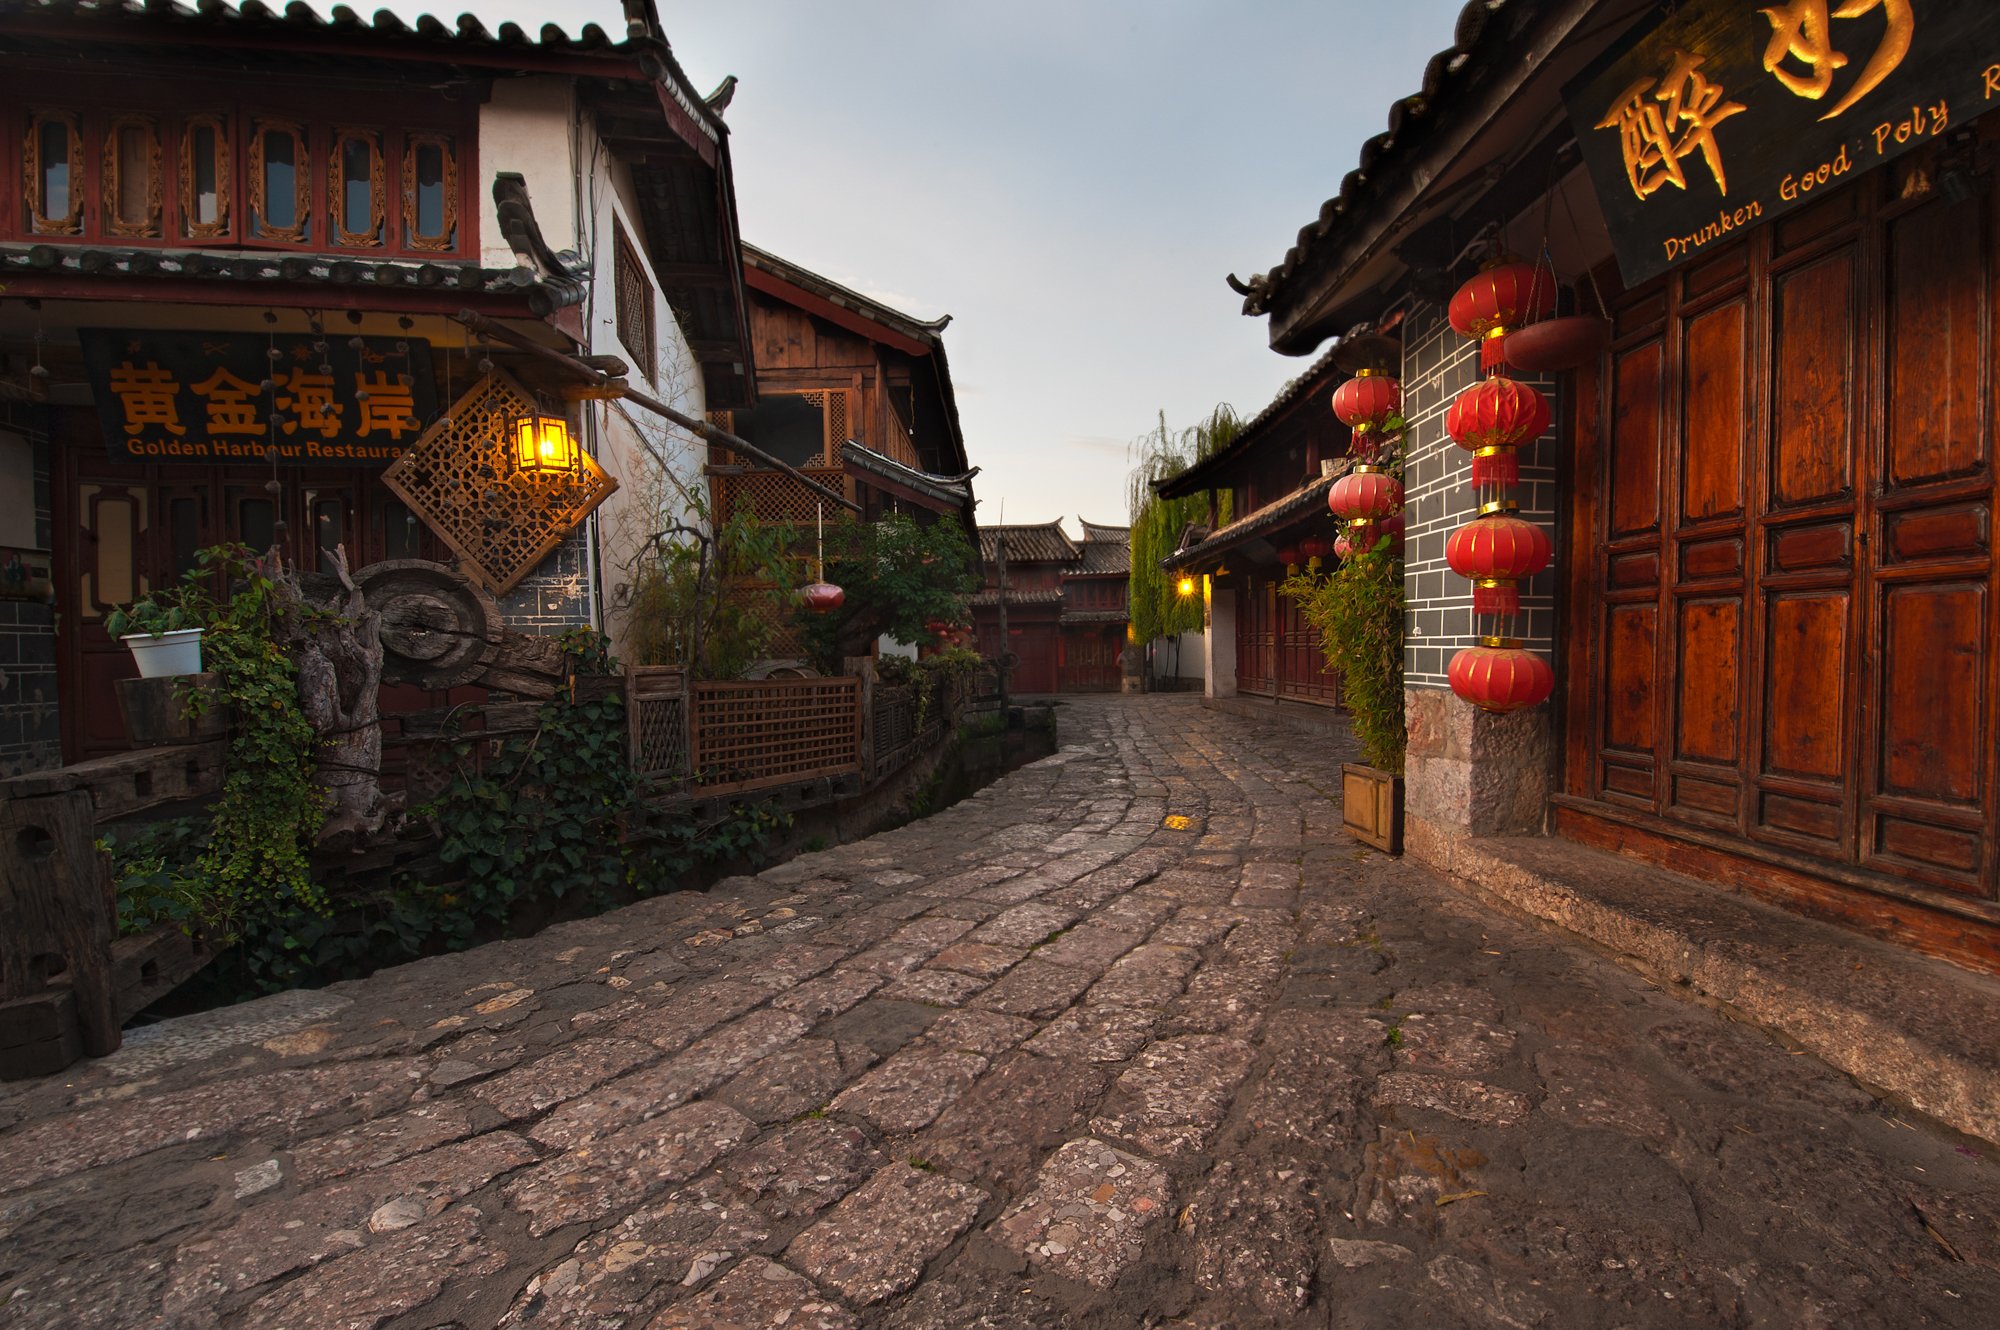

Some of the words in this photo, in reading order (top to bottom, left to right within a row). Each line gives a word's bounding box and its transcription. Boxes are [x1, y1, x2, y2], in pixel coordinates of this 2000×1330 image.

[1664, 201, 1763, 261] Drunken
[1779, 145, 1852, 201] Good
[1873, 100, 1949, 154] Poly
[110, 361, 421, 438] 黄金海岸
[127, 438, 207, 456] Golden
[307, 442, 408, 458] Restaura
